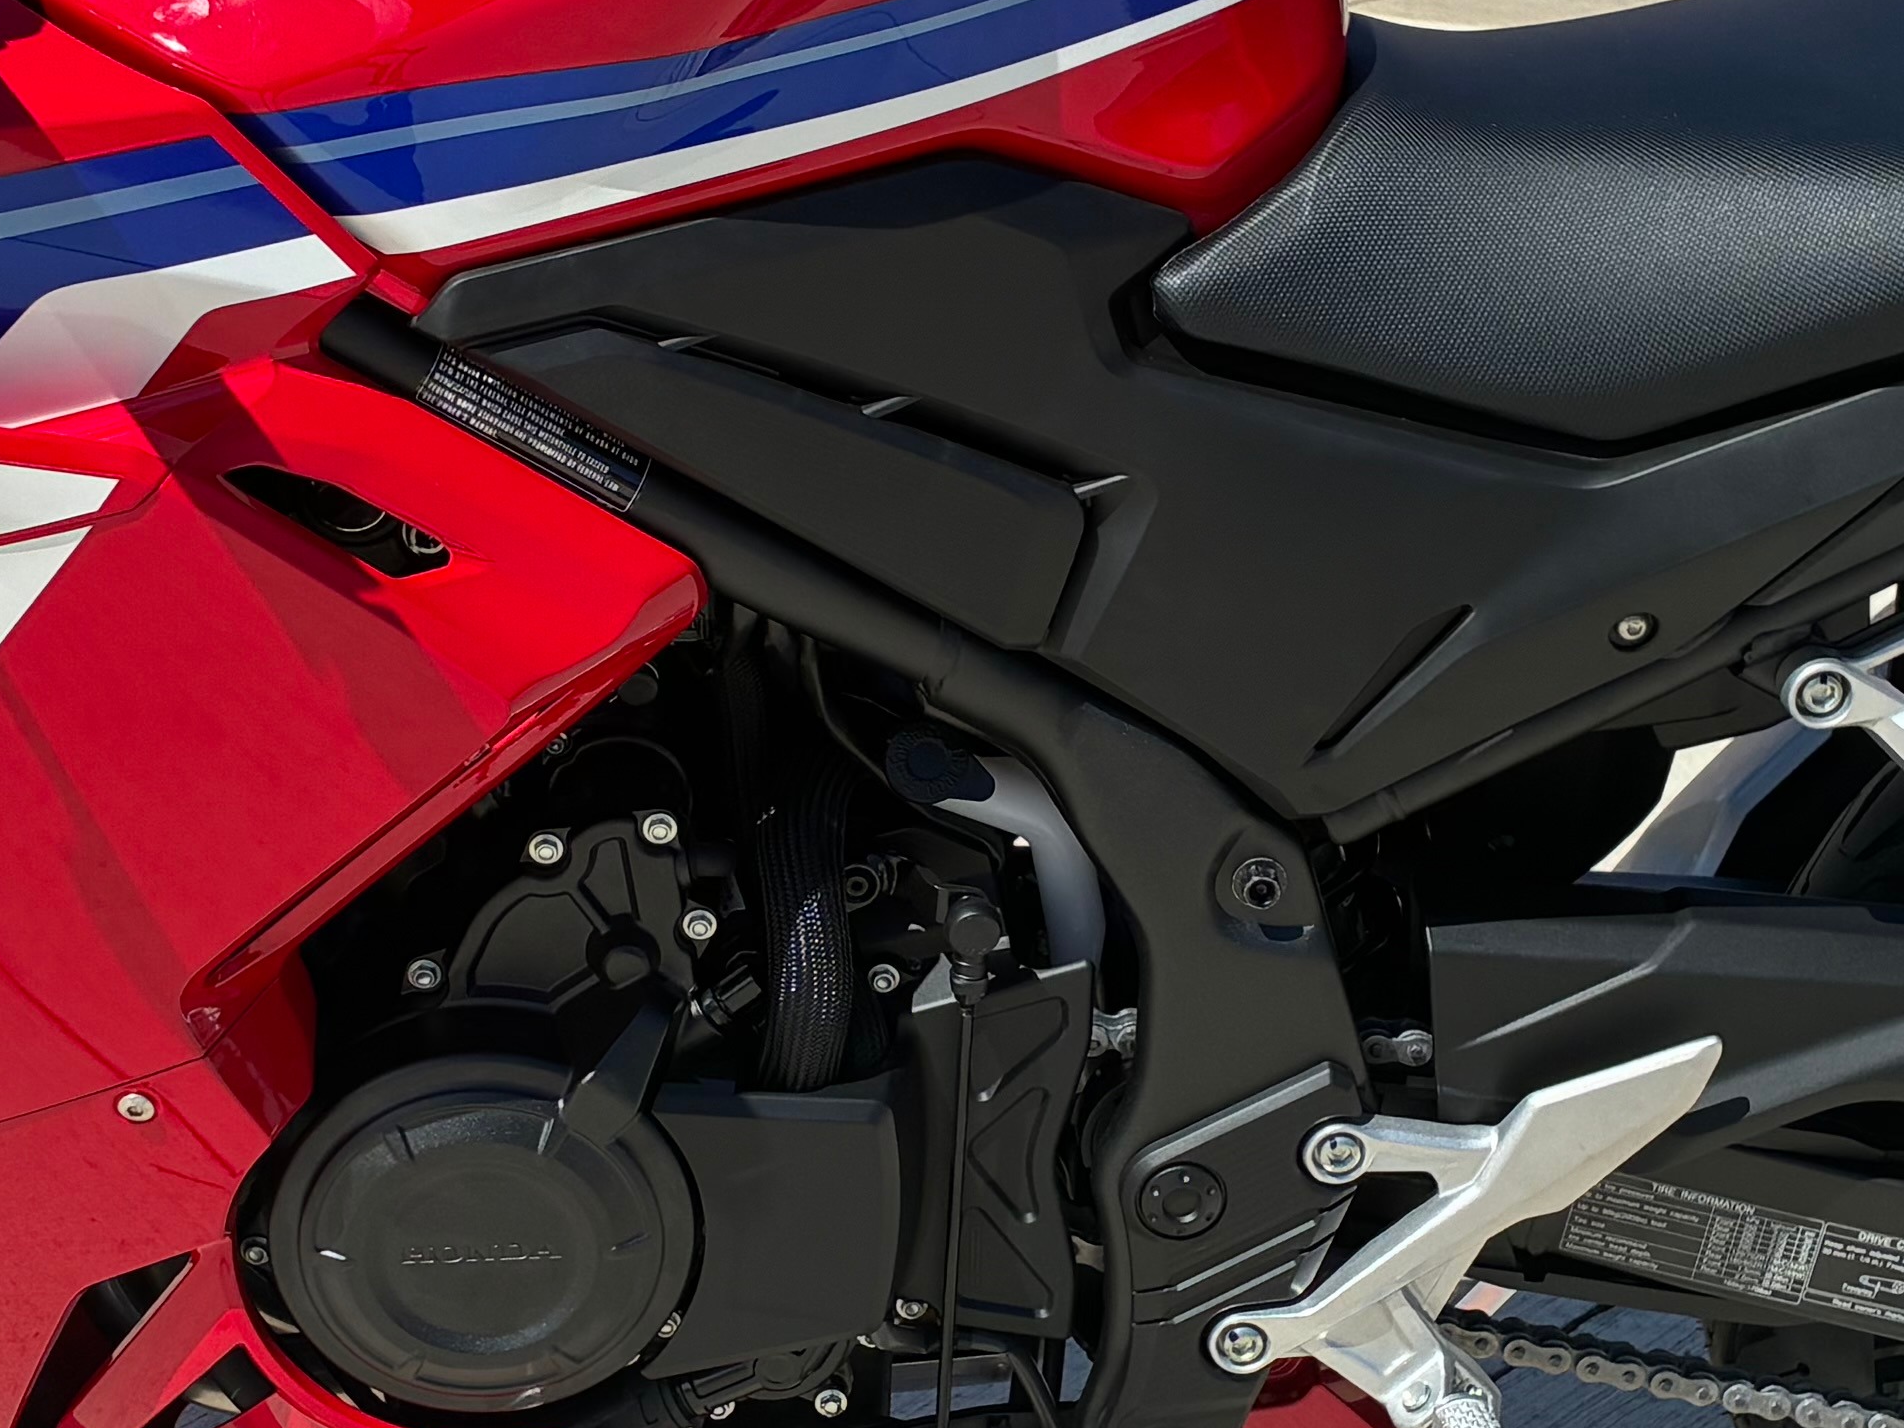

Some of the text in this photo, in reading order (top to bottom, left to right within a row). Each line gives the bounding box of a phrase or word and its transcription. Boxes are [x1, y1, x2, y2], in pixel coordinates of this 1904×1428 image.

[1652, 1182, 1677, 1197] TIRE
[1681, 1188, 1757, 1215] INFORMATION
[1858, 1230, 1892, 1248] DRIVE
[401, 1243, 563, 1266] HONDA
